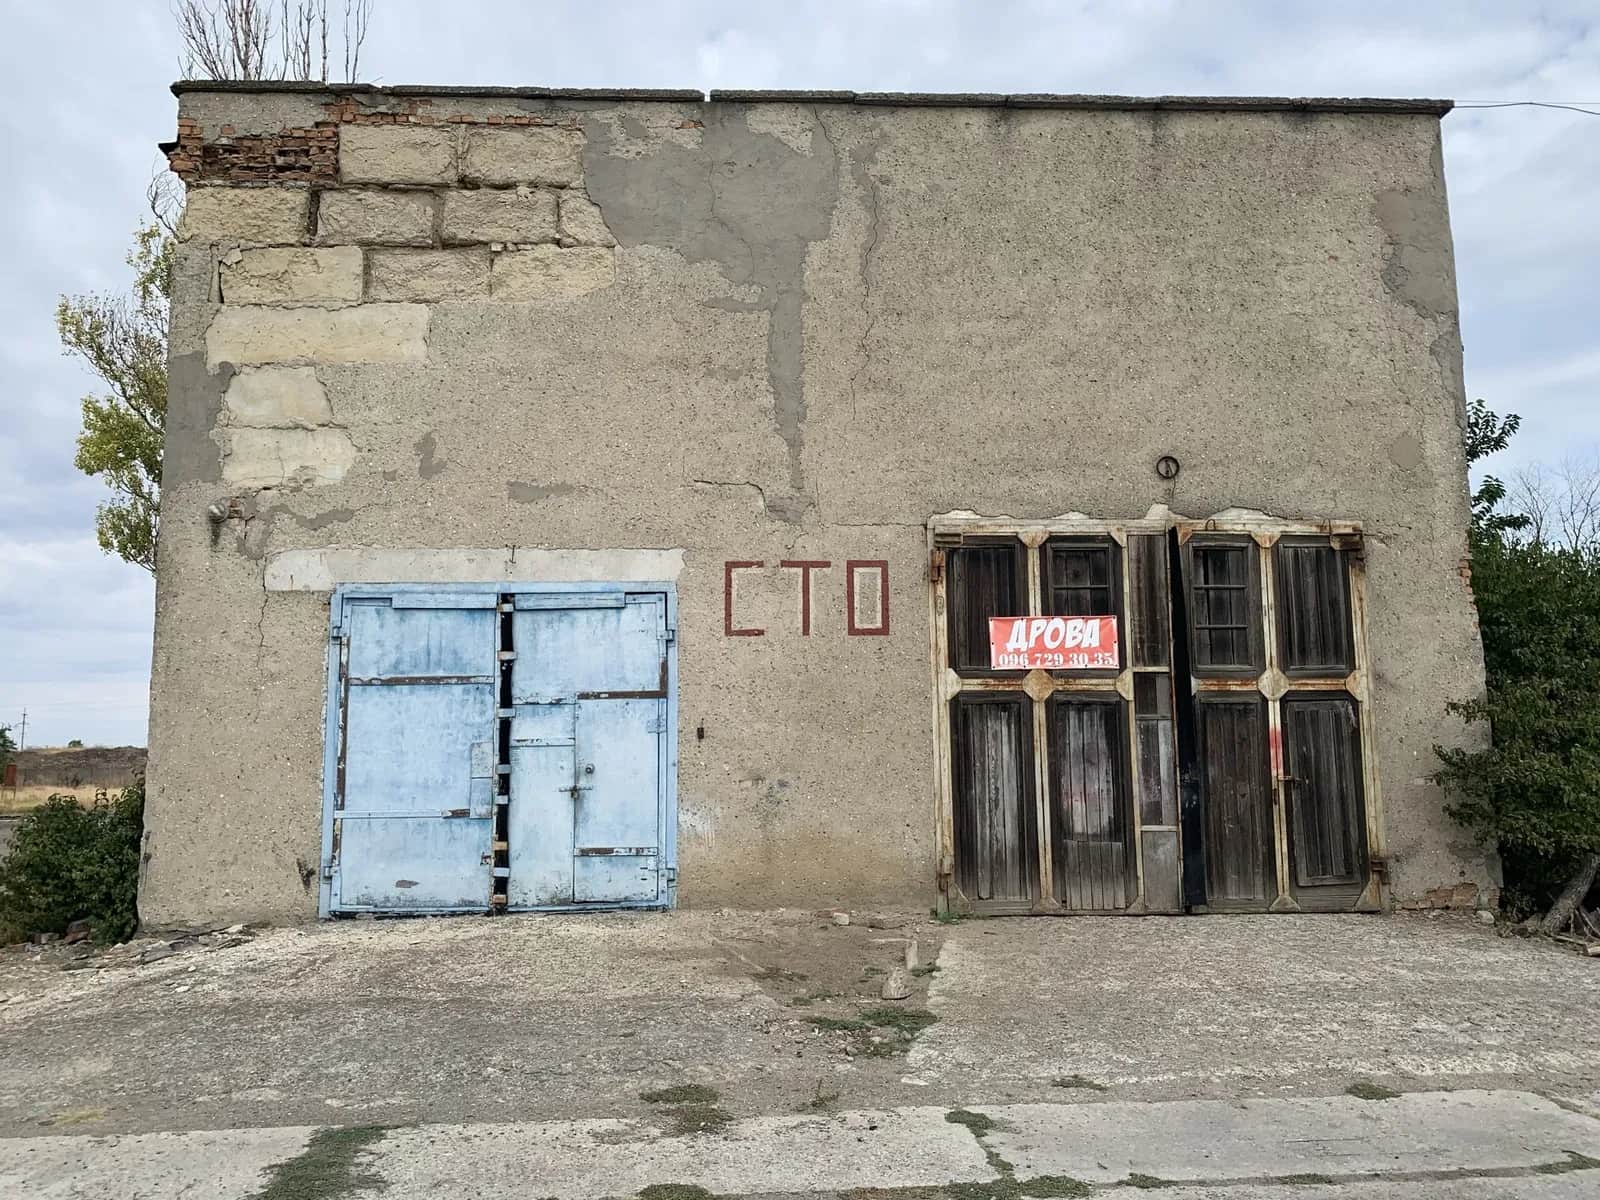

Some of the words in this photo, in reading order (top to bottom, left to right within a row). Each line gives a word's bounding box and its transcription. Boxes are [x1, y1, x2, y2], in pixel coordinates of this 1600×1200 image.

[725, 560, 889, 636] СТО
[1006, 618, 1100, 652] ДРОВА
[999, 653, 1029, 666] 096
[1035, 652, 1064, 666] 729
[1069, 652, 1089, 666] 30
[1094, 652, 1113, 666] 35
